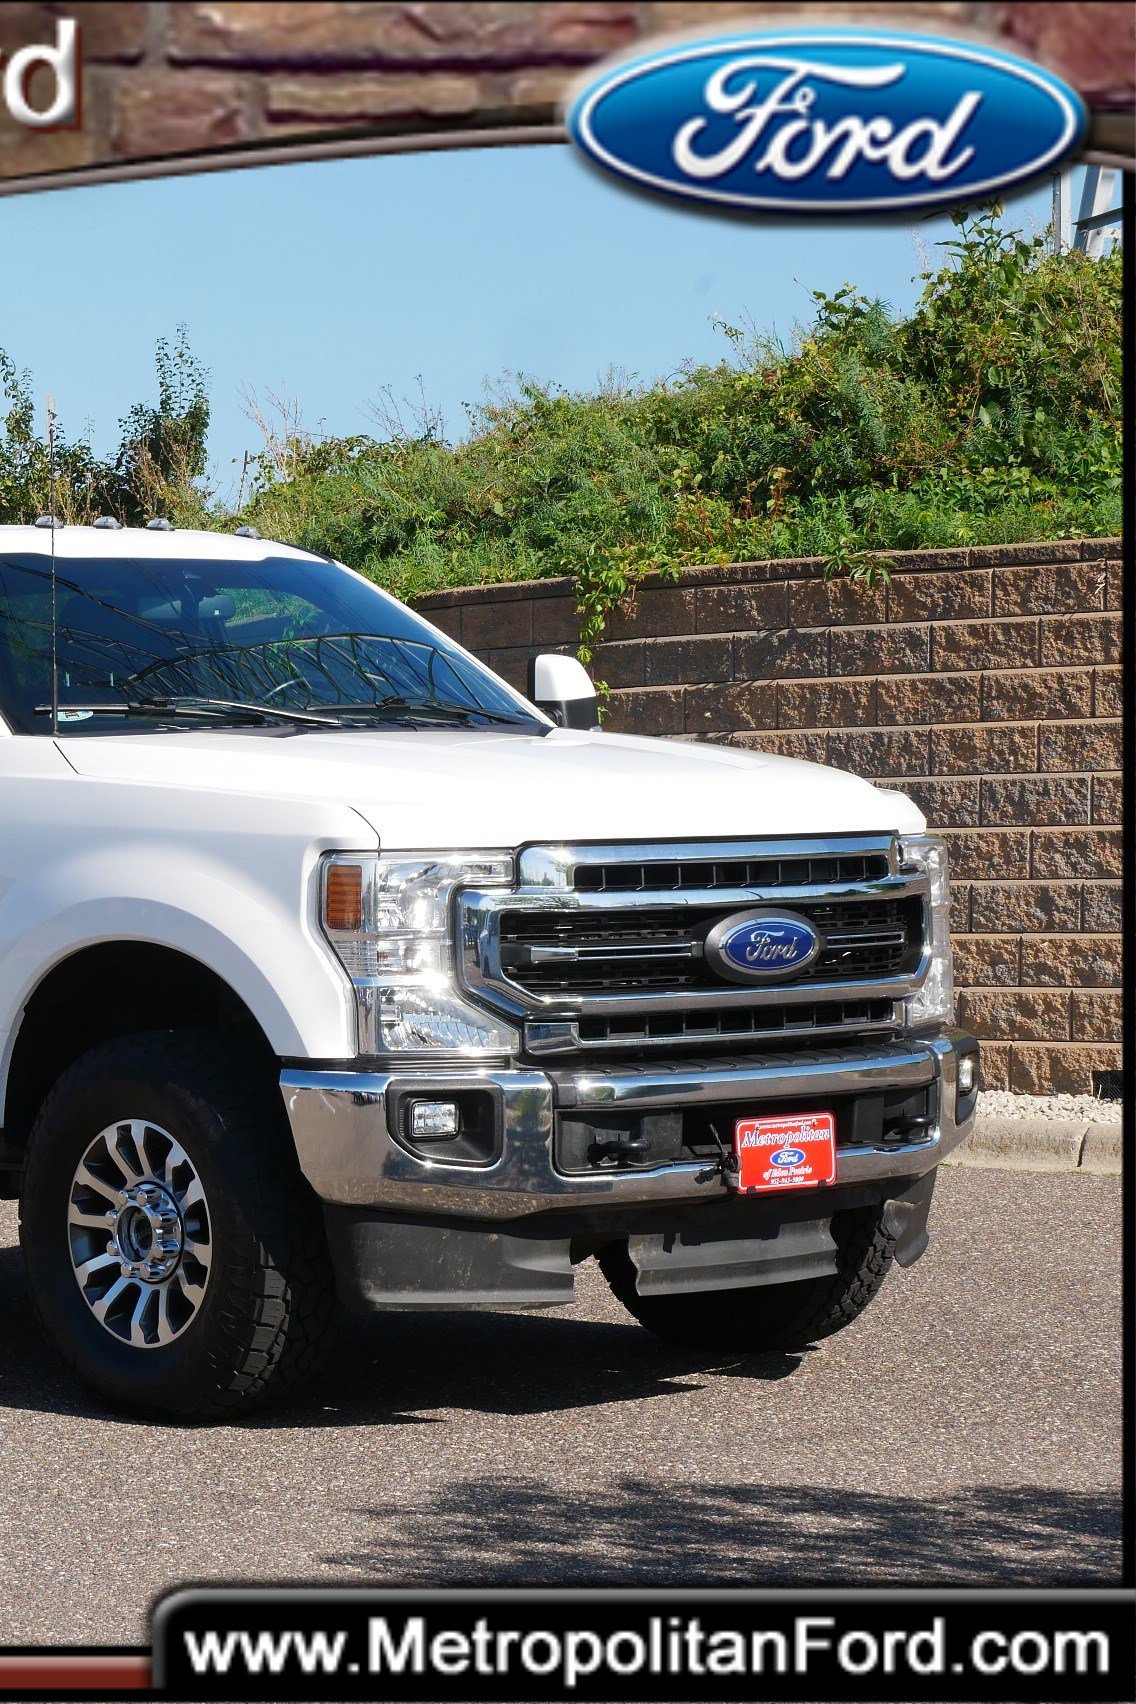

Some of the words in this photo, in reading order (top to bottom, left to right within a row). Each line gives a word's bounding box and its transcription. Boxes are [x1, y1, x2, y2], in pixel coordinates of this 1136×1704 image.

[746, 930, 797, 961] Ford
[741, 1126, 831, 1149] Metropolitan
[778, 1152, 798, 1163] Ford
